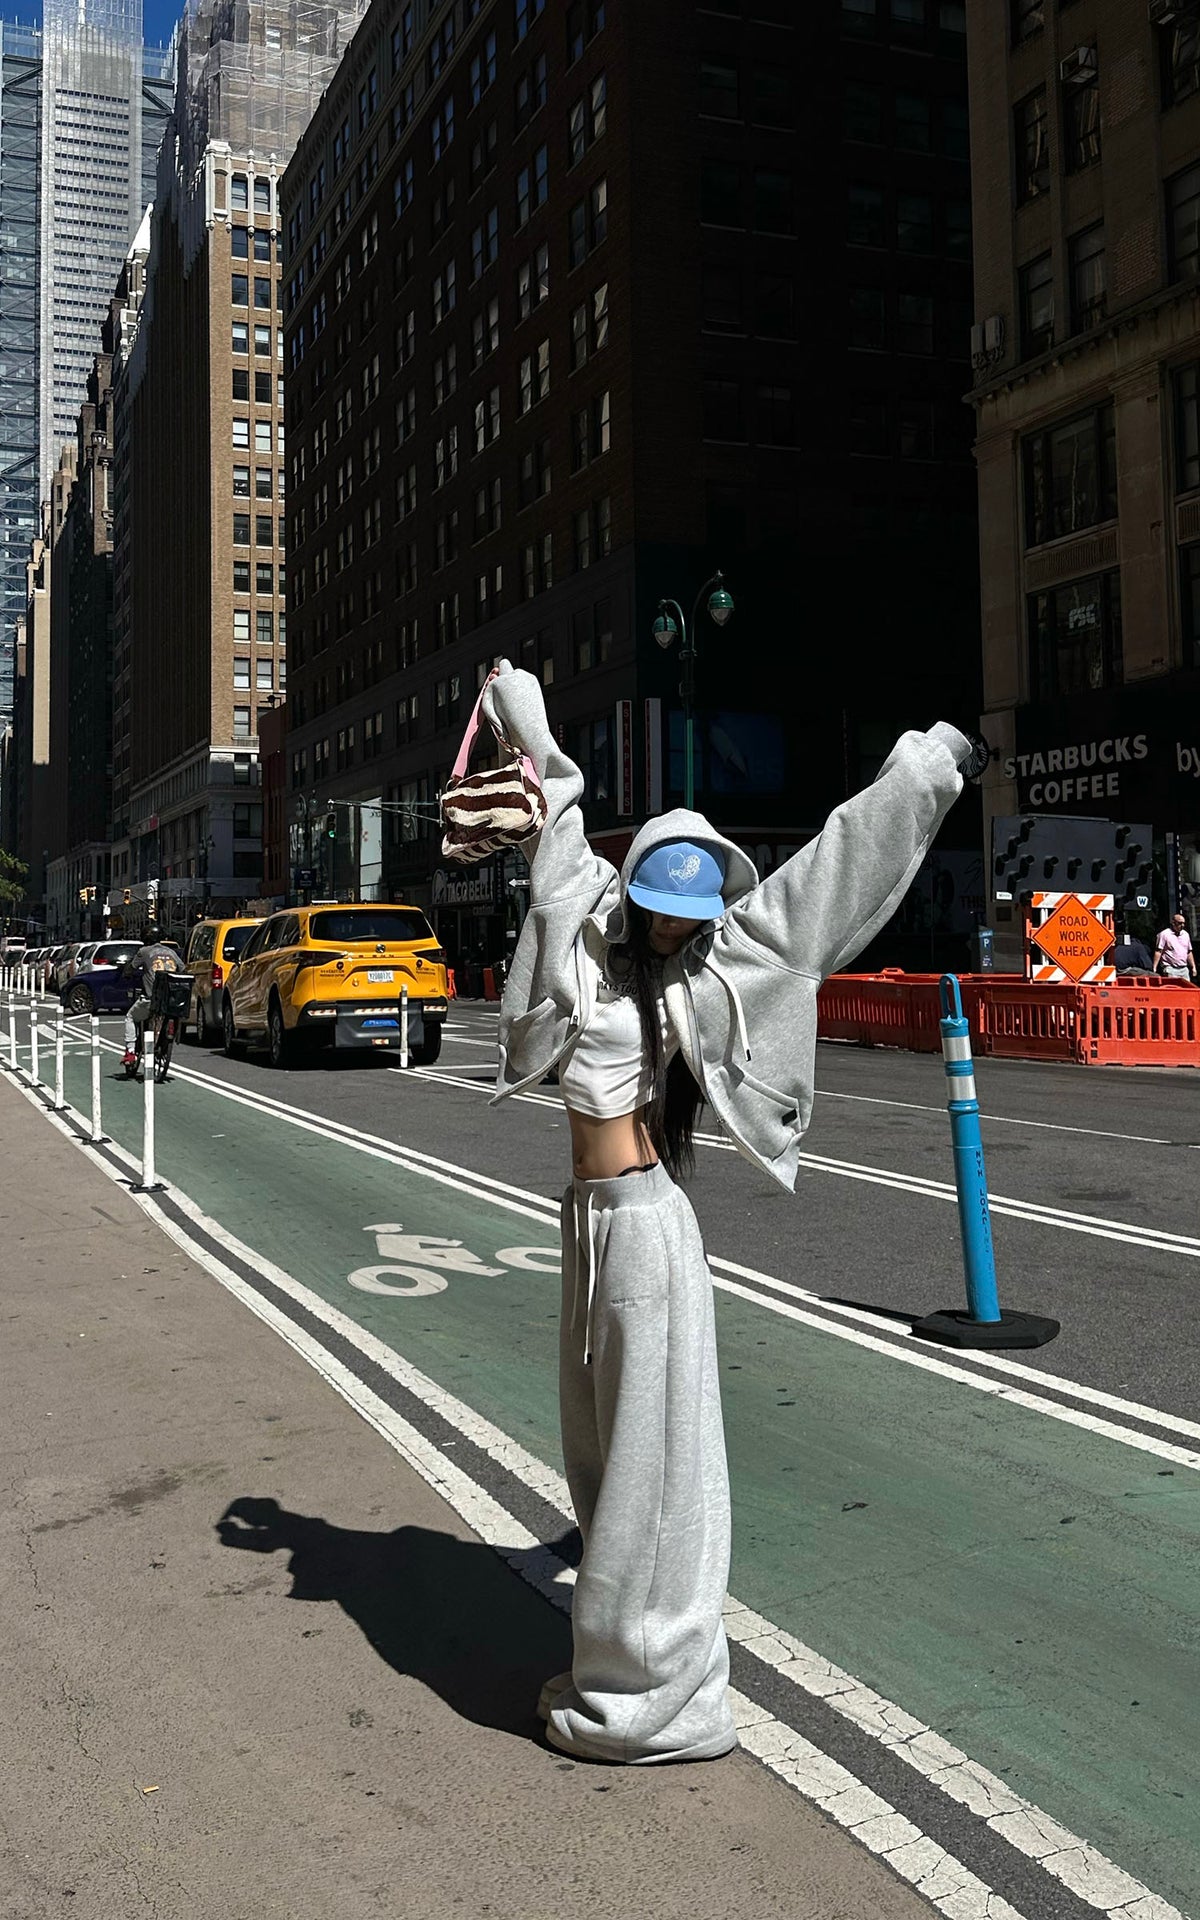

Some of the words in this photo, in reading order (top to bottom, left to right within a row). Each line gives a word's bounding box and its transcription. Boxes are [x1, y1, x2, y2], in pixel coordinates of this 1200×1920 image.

[623, 709, 631, 807] STAPLES
[1003, 734, 1149, 779] STARBUCKS
[1029, 772, 1120, 806] COFFEE
[446, 880, 467, 902] TACO
[469, 878, 490, 901] BELL
[1059, 915, 1088, 927] ROAD
[1059, 931, 1090, 942] WORK
[1057, 945, 1094, 957] AHEAD
